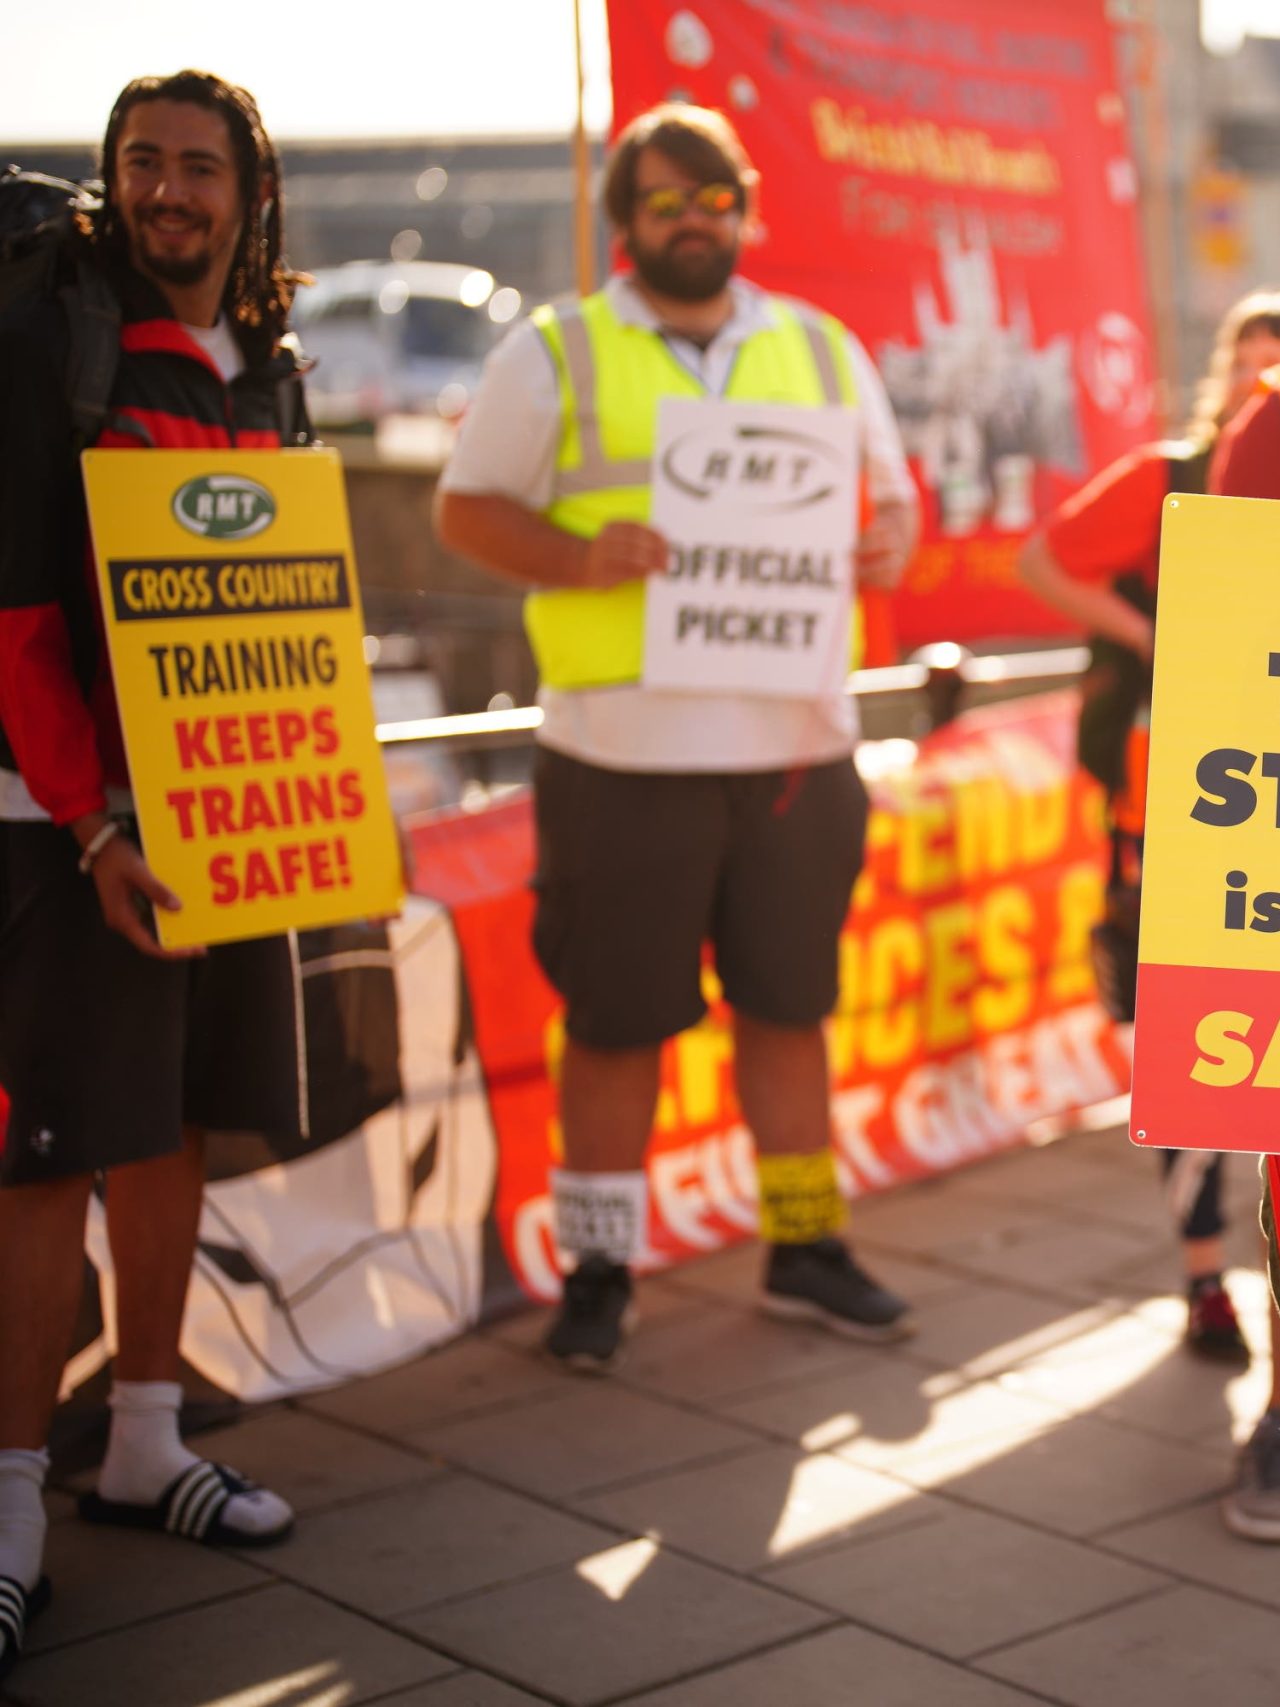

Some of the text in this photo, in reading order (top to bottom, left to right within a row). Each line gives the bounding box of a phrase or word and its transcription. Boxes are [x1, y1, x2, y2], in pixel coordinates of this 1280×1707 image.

[700, 452, 812, 486] RMT
[196, 492, 257, 522] RMT
[122, 560, 339, 613] CROSS COUNTRY
[676, 606, 816, 648] PICKET
[149, 634, 337, 698] TRAINING
[174, 704, 340, 771] KEEPS
[166, 767, 366, 841] TRAINS
[208, 835, 352, 907] SAFE!
